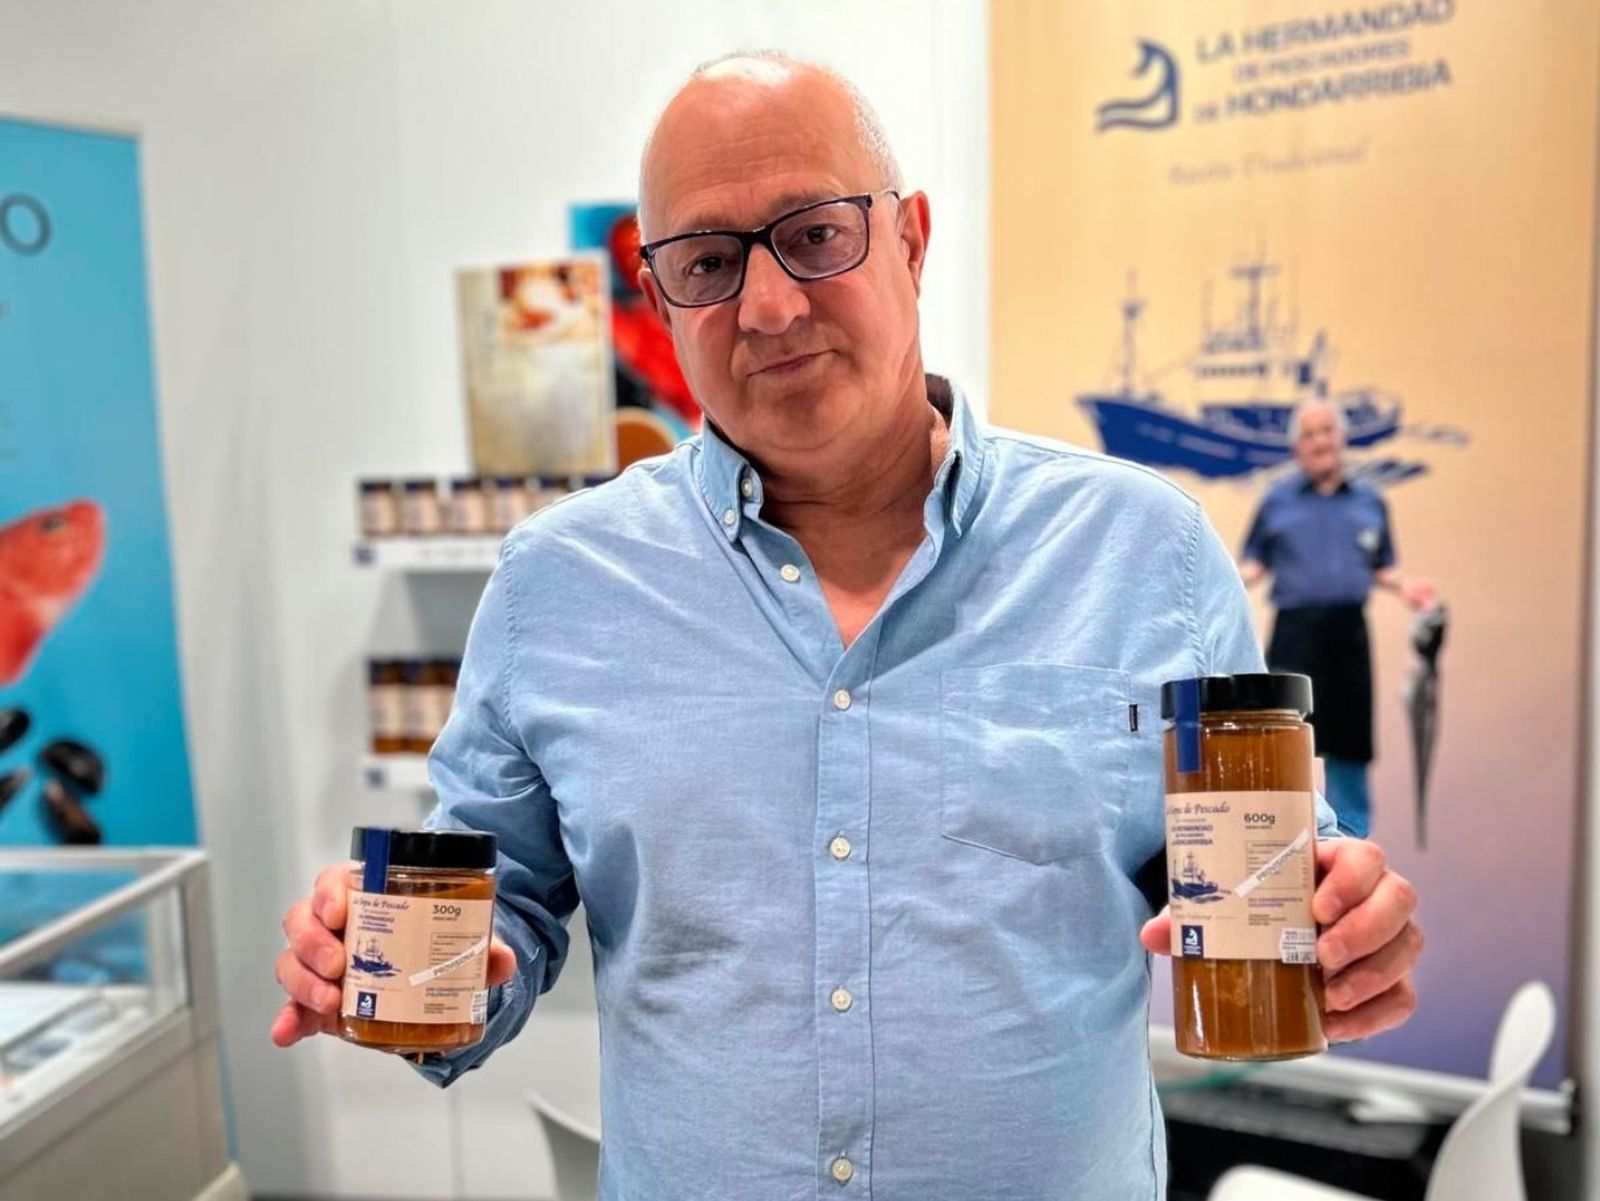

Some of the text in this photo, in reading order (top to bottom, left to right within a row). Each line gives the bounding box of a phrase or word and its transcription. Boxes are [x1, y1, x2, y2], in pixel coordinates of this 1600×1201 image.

[1196, 0, 1455, 62] LA HERMANDAD
[1235, 63, 1259, 81] DE
[1226, 58, 1451, 115] HONDARRIBIA
[1193, 800, 1231, 815] Pescado
[1244, 813, 1275, 825] 600g
[432, 904, 462, 917] 300g
